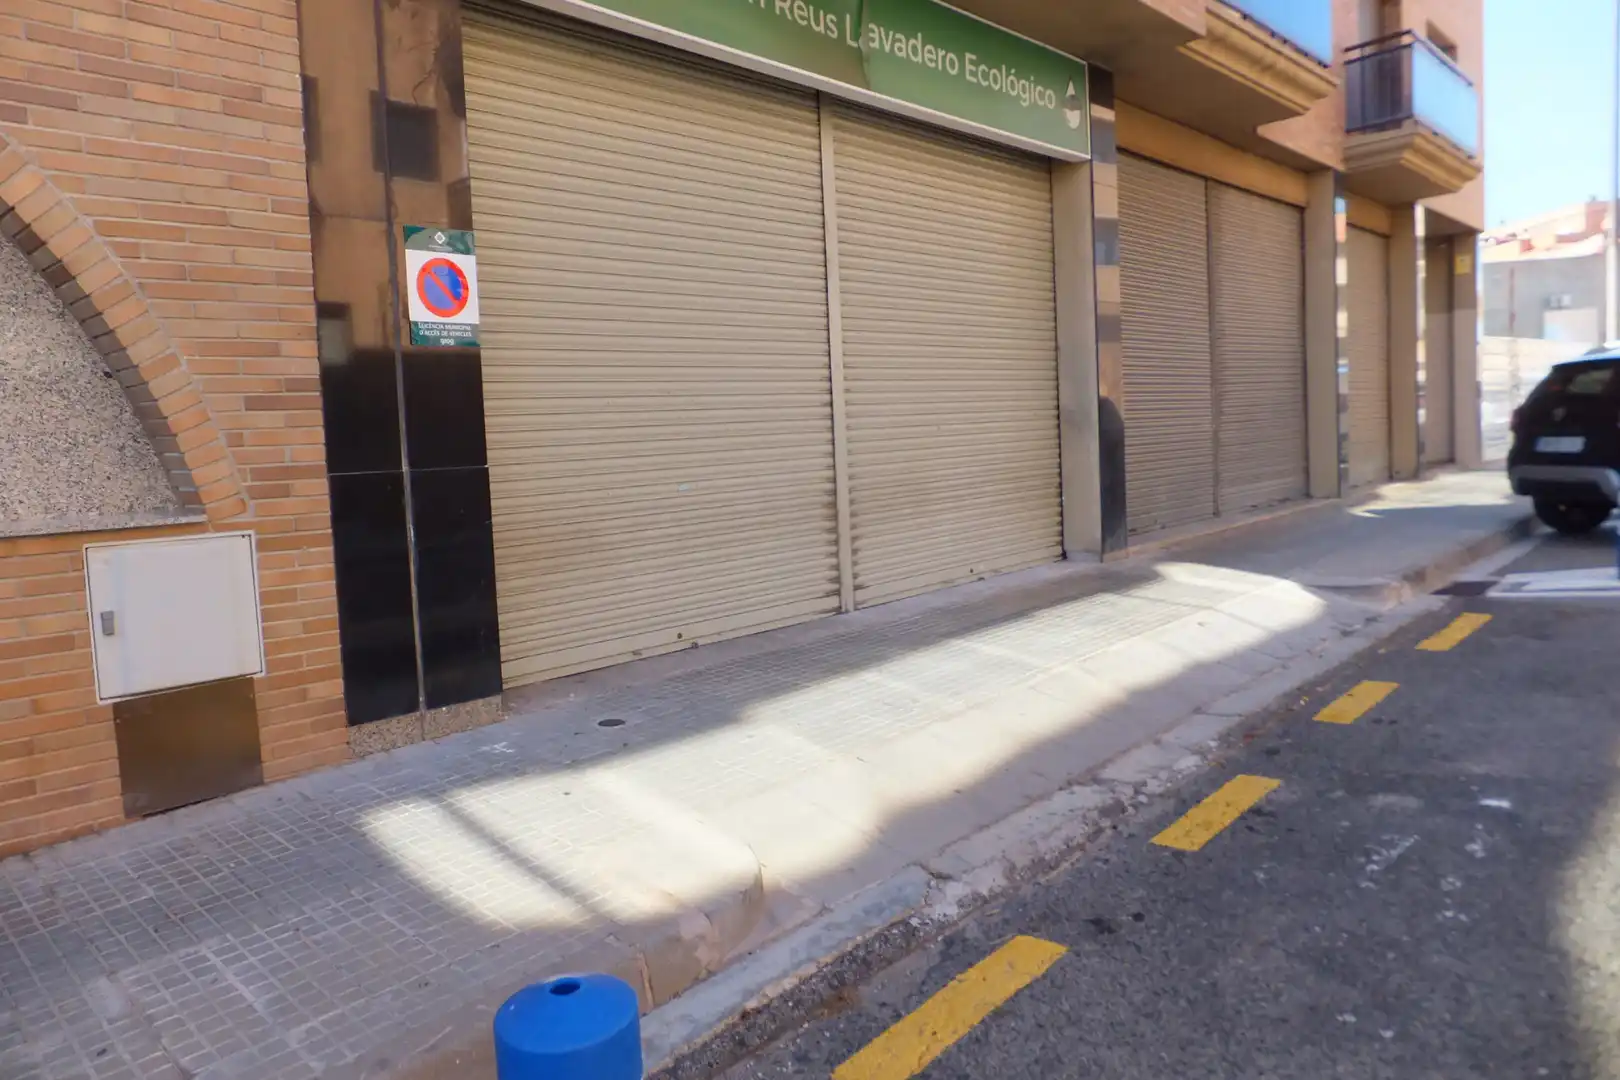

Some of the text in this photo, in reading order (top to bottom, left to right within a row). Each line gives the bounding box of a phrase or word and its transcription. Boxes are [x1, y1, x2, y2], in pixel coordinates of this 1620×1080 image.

[775, 0, 1056, 110] Reus Lavadero Ecológico
